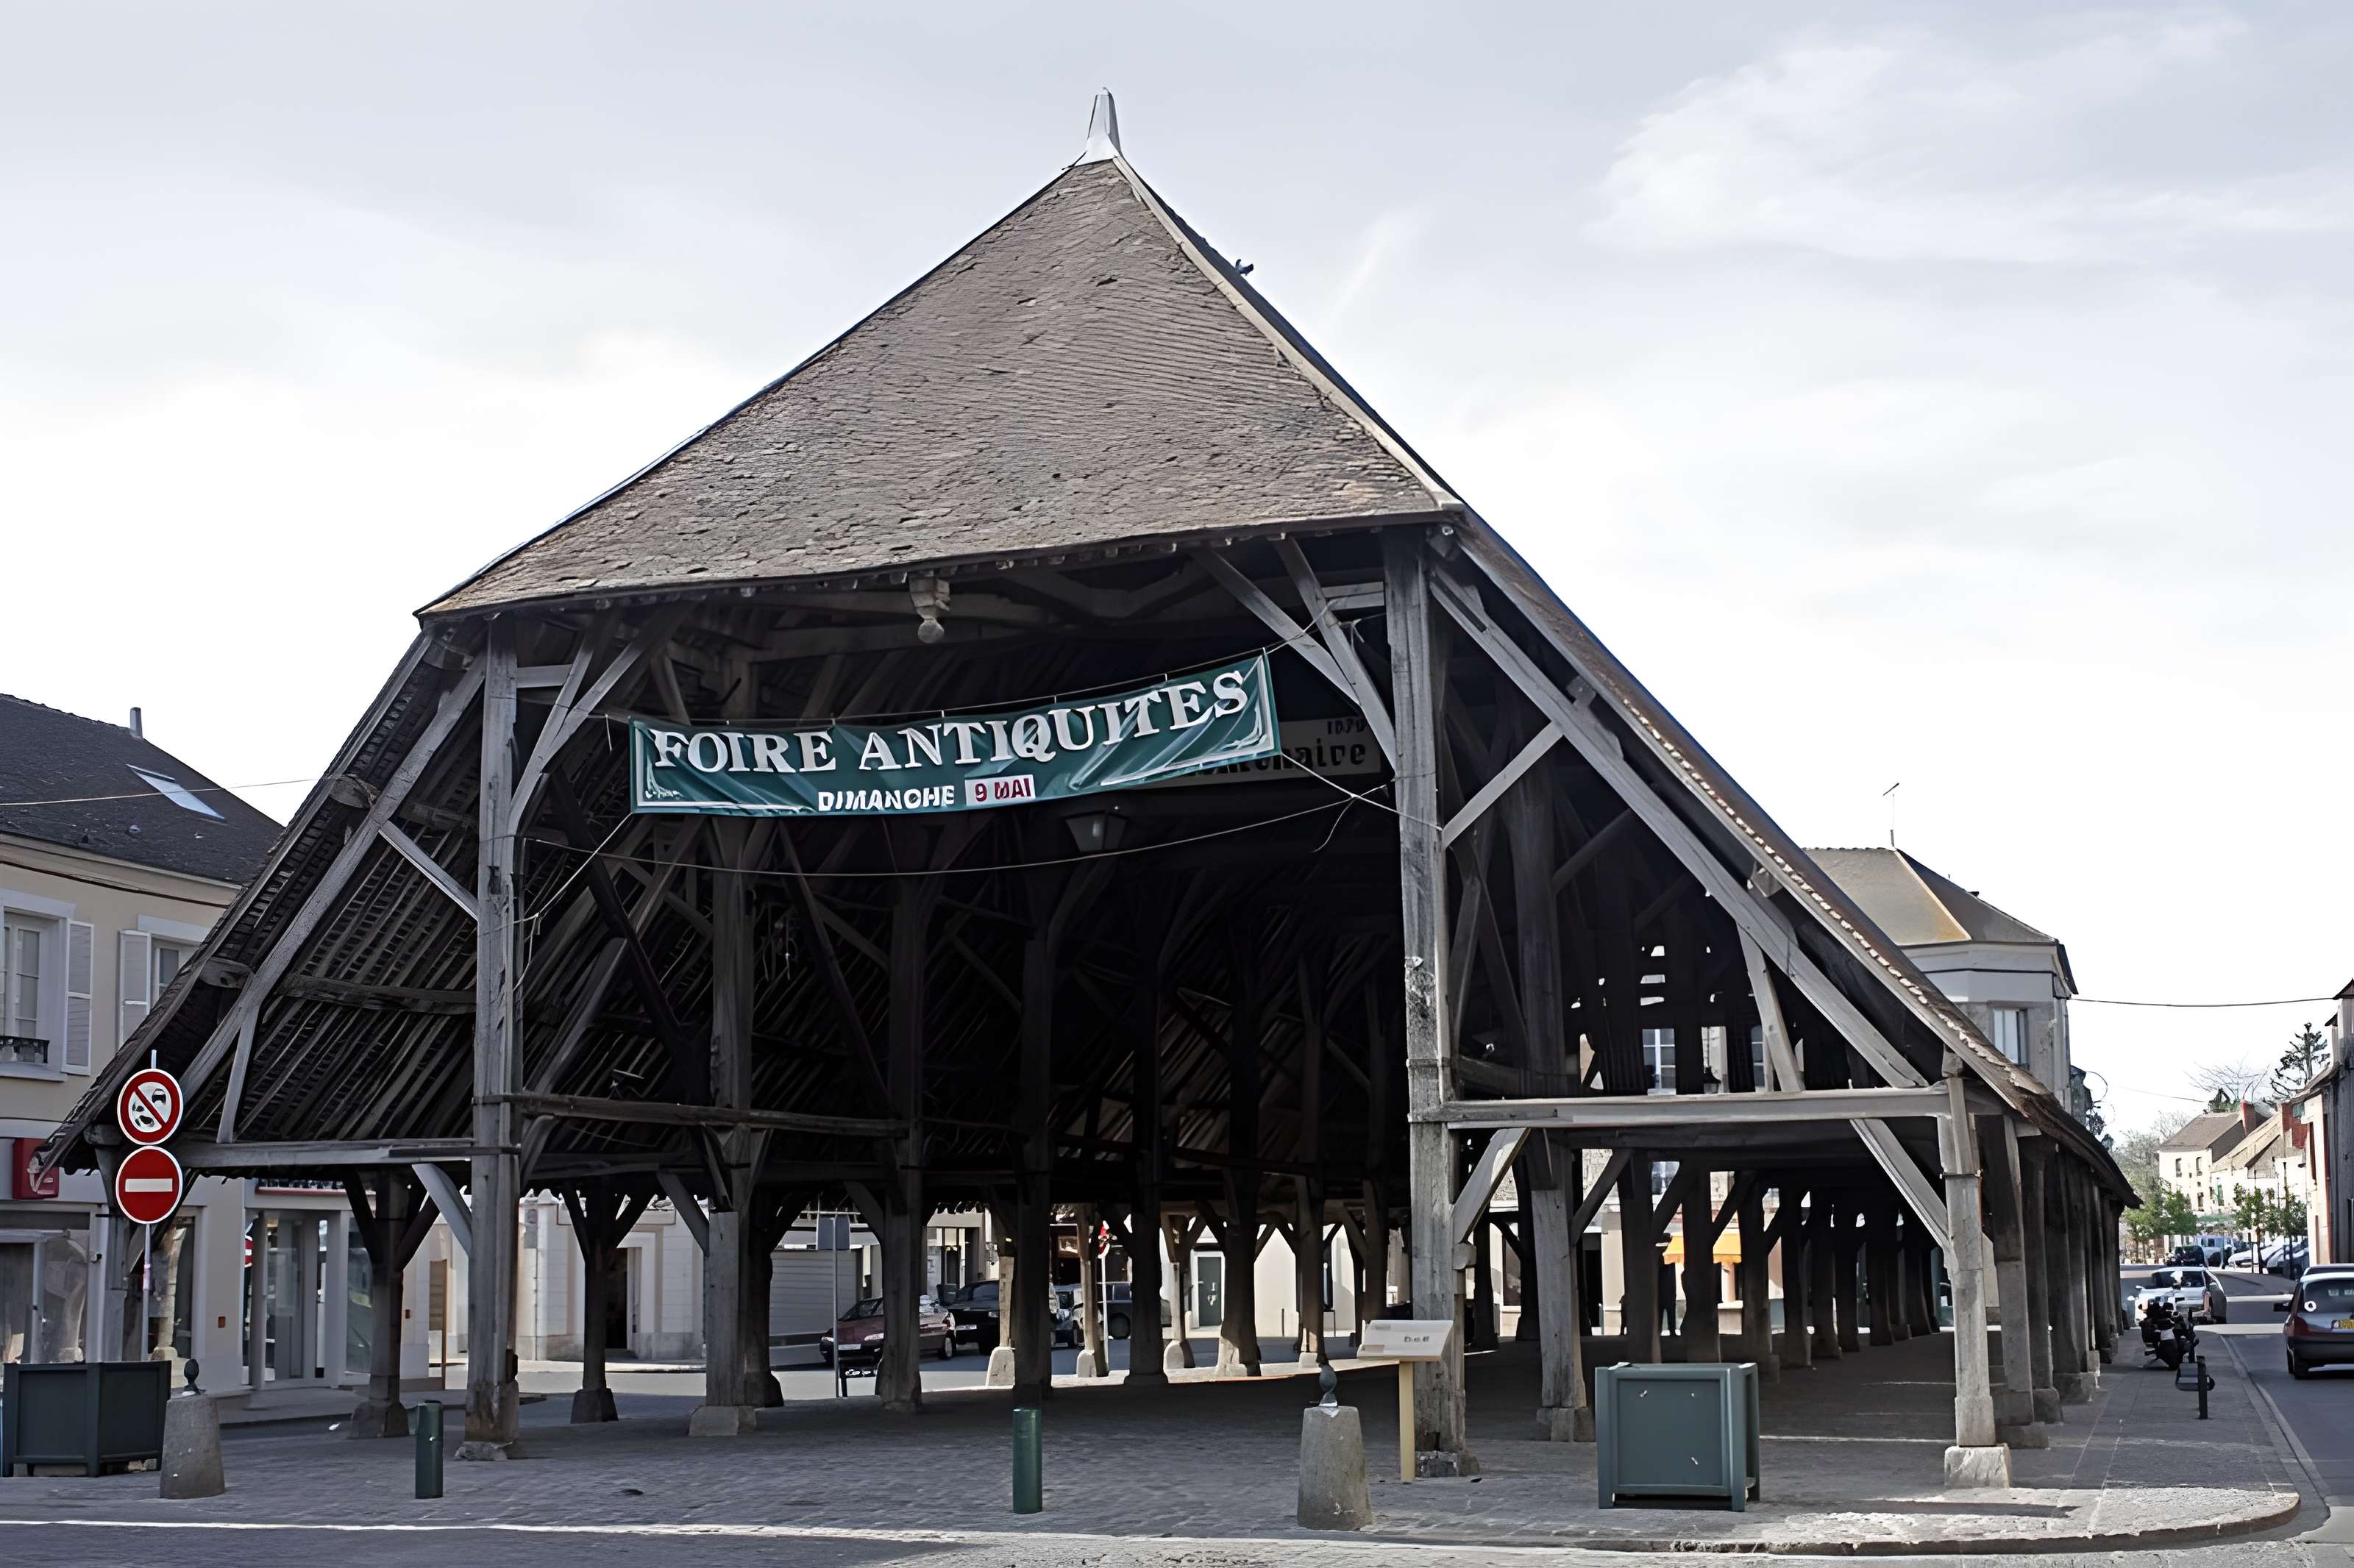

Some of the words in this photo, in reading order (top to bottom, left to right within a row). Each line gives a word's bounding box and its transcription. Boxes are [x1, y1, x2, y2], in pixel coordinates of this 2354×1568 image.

[649, 728, 836, 773] FOIRE
[858, 669, 1249, 771] ANTIQUITES
[818, 785, 955, 812] DIMANCHE
[975, 783, 987, 802] 9
[994, 777, 1031, 800] MAI
